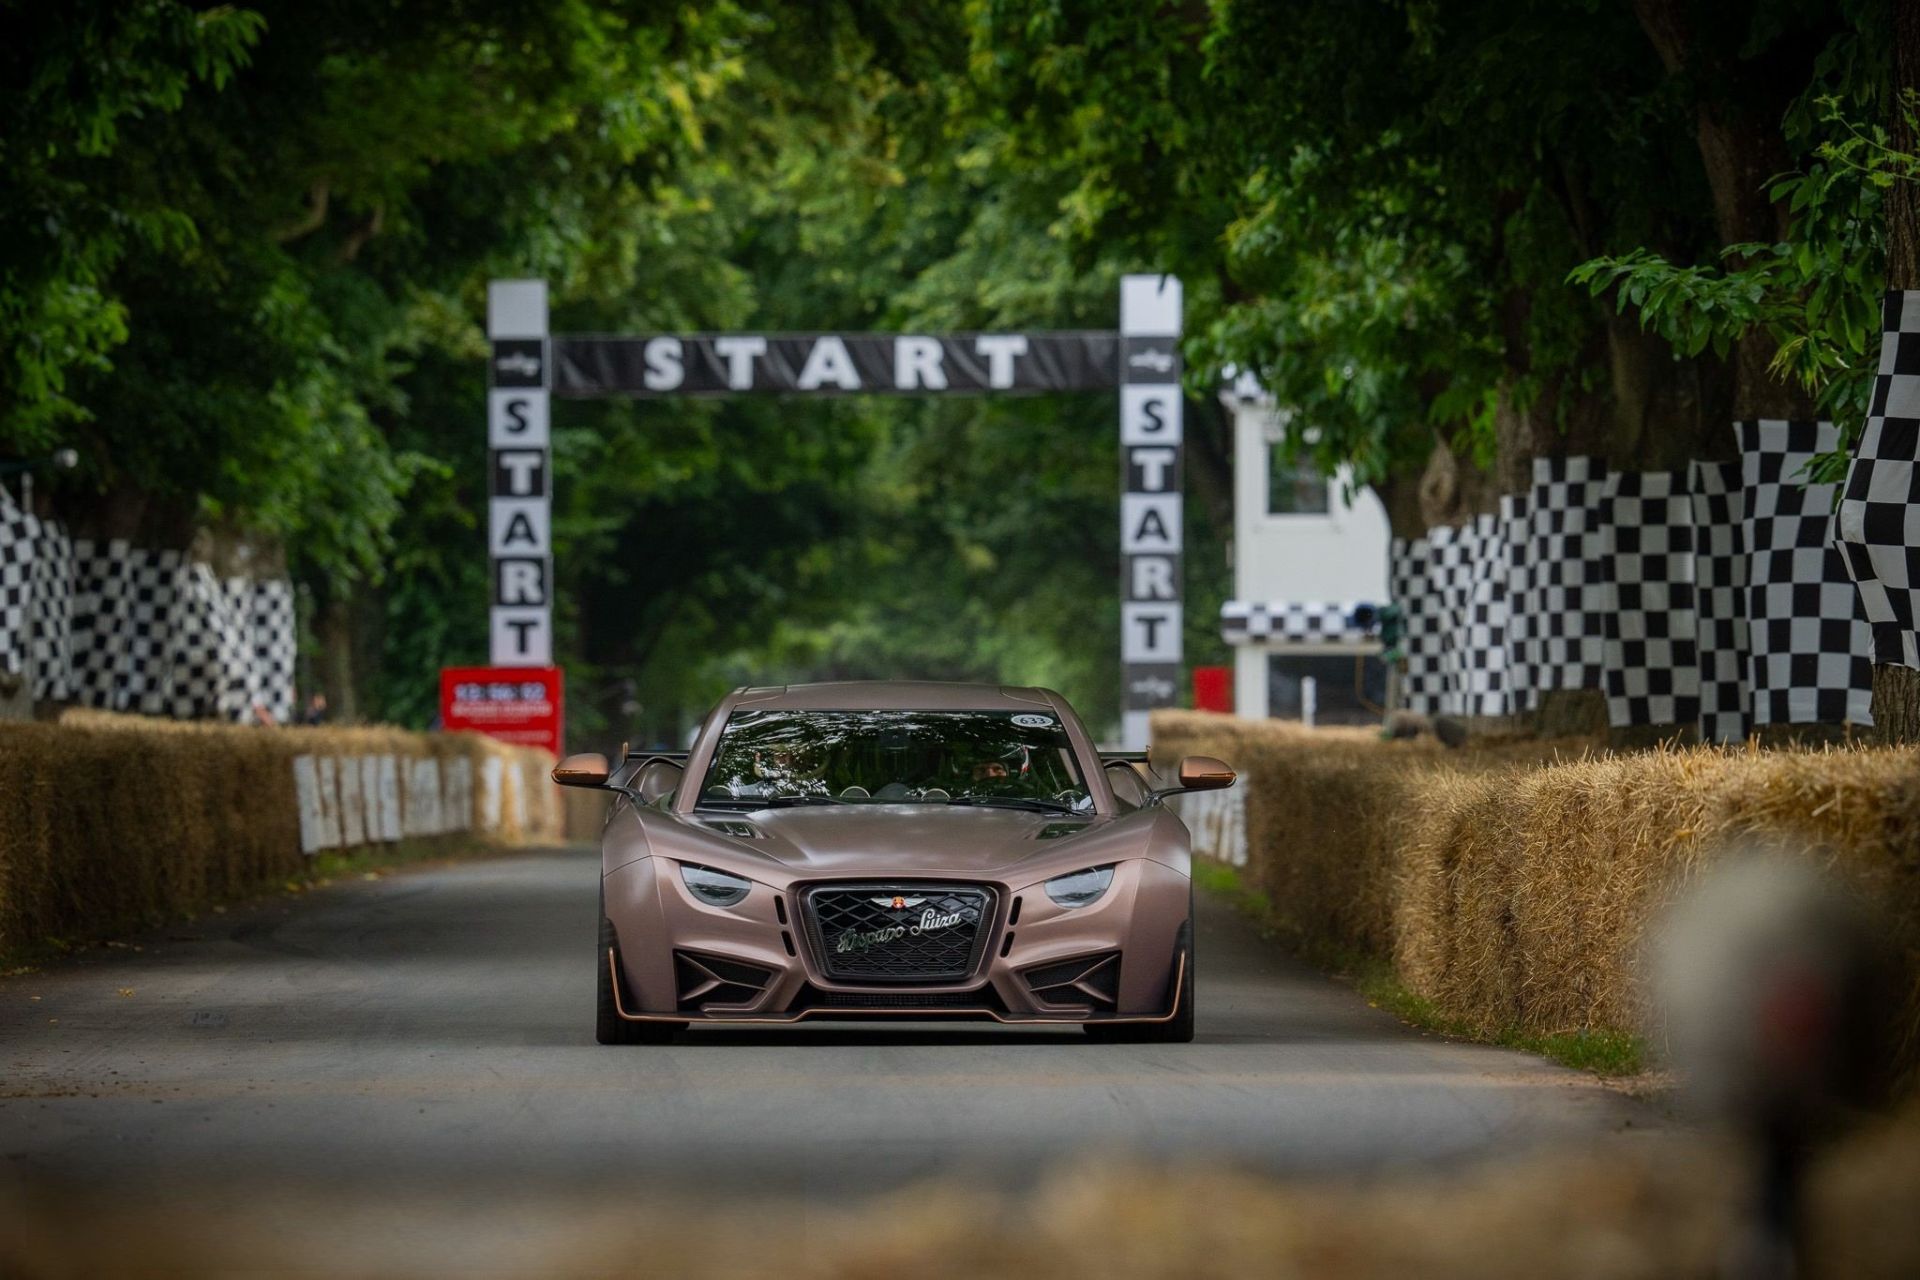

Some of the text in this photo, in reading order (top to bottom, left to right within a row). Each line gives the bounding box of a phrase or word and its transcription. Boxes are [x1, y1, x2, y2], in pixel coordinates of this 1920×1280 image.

[643, 335, 1029, 391] START
[500, 399, 543, 655] START
[1131, 398, 1176, 650] START
[1019, 717, 1046, 725] 633
